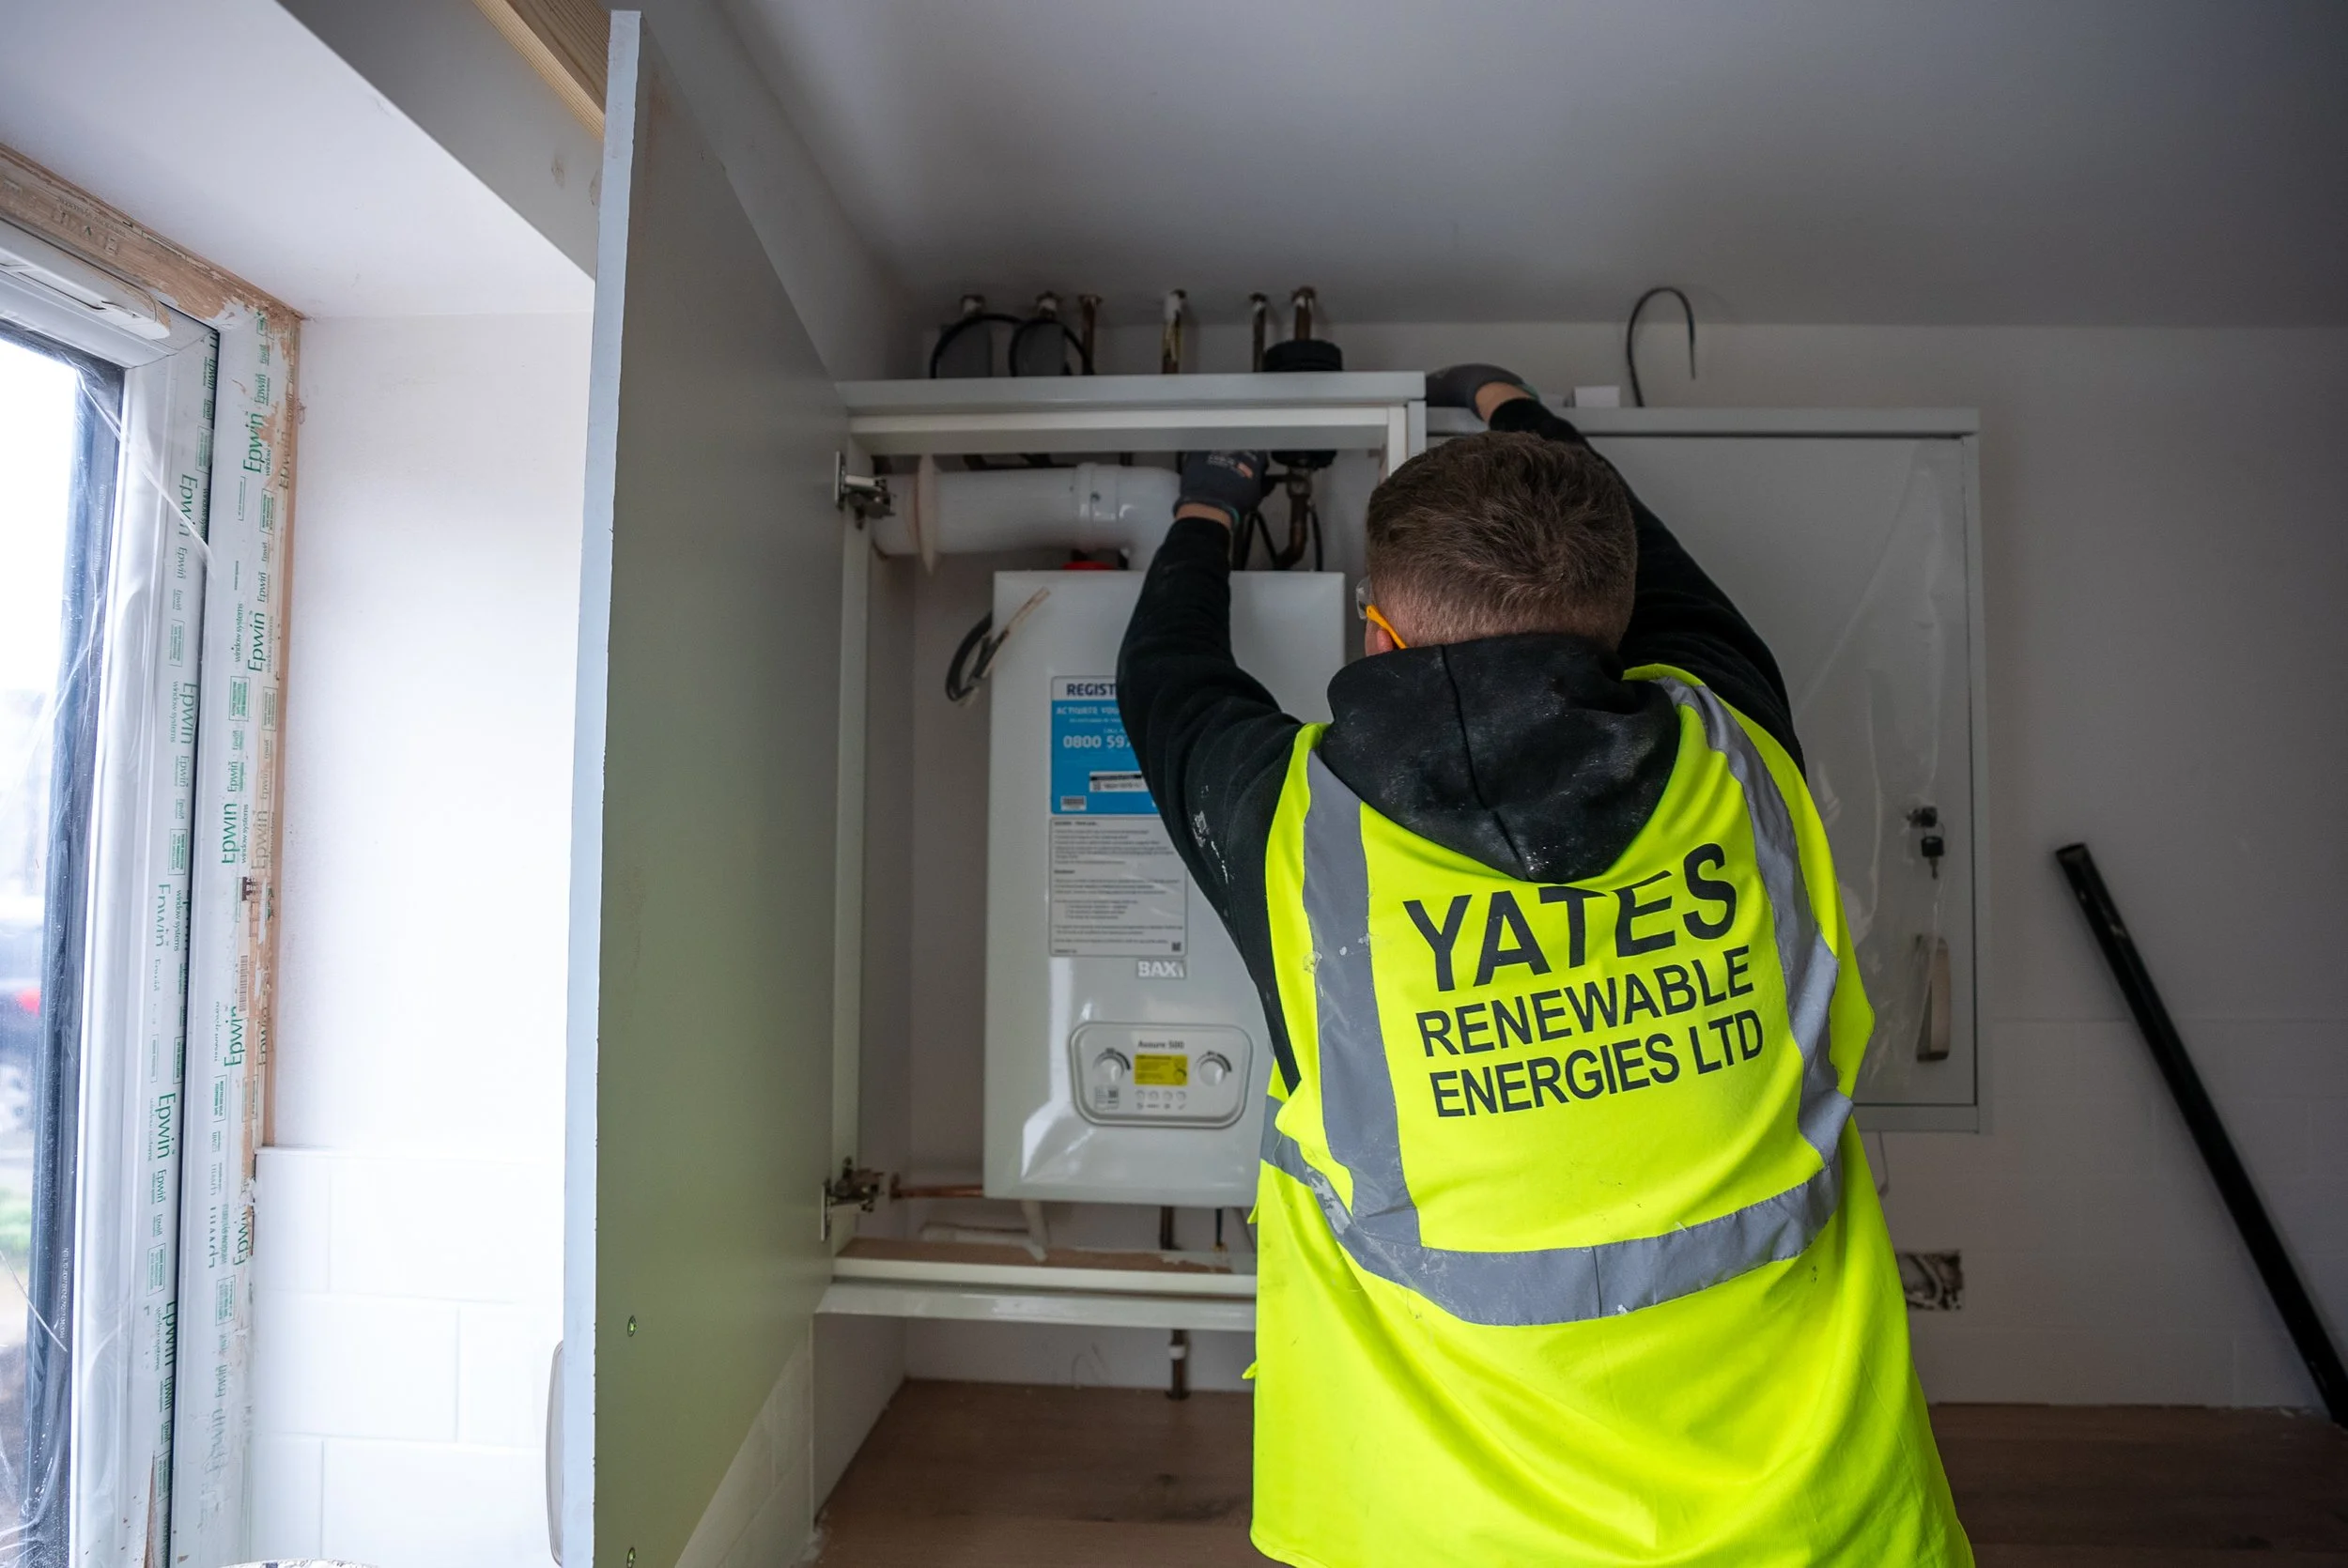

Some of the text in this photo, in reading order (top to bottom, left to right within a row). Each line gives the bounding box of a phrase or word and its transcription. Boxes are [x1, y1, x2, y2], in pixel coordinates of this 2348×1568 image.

[243, 411, 264, 473] Epwin
[177, 546, 188, 579] Epwin
[257, 572, 267, 603] Epwin
[234, 603, 244, 663] window systems
[248, 612, 267, 672] Epwin
[169, 712, 178, 743] systems
[1063, 735, 1102, 749] 0800
[227, 761, 239, 792] Epwin
[222, 802, 240, 864] Epwin
[173, 920, 181, 952] systems
[1402, 842, 1738, 992] YATES
[1415, 945, 1754, 1057] RENEWABLE
[1429, 1008, 1764, 1117] ENERGIES LTD
[156, 1092, 176, 1160] Epwin
[156, 1169, 167, 1204] Epwin
